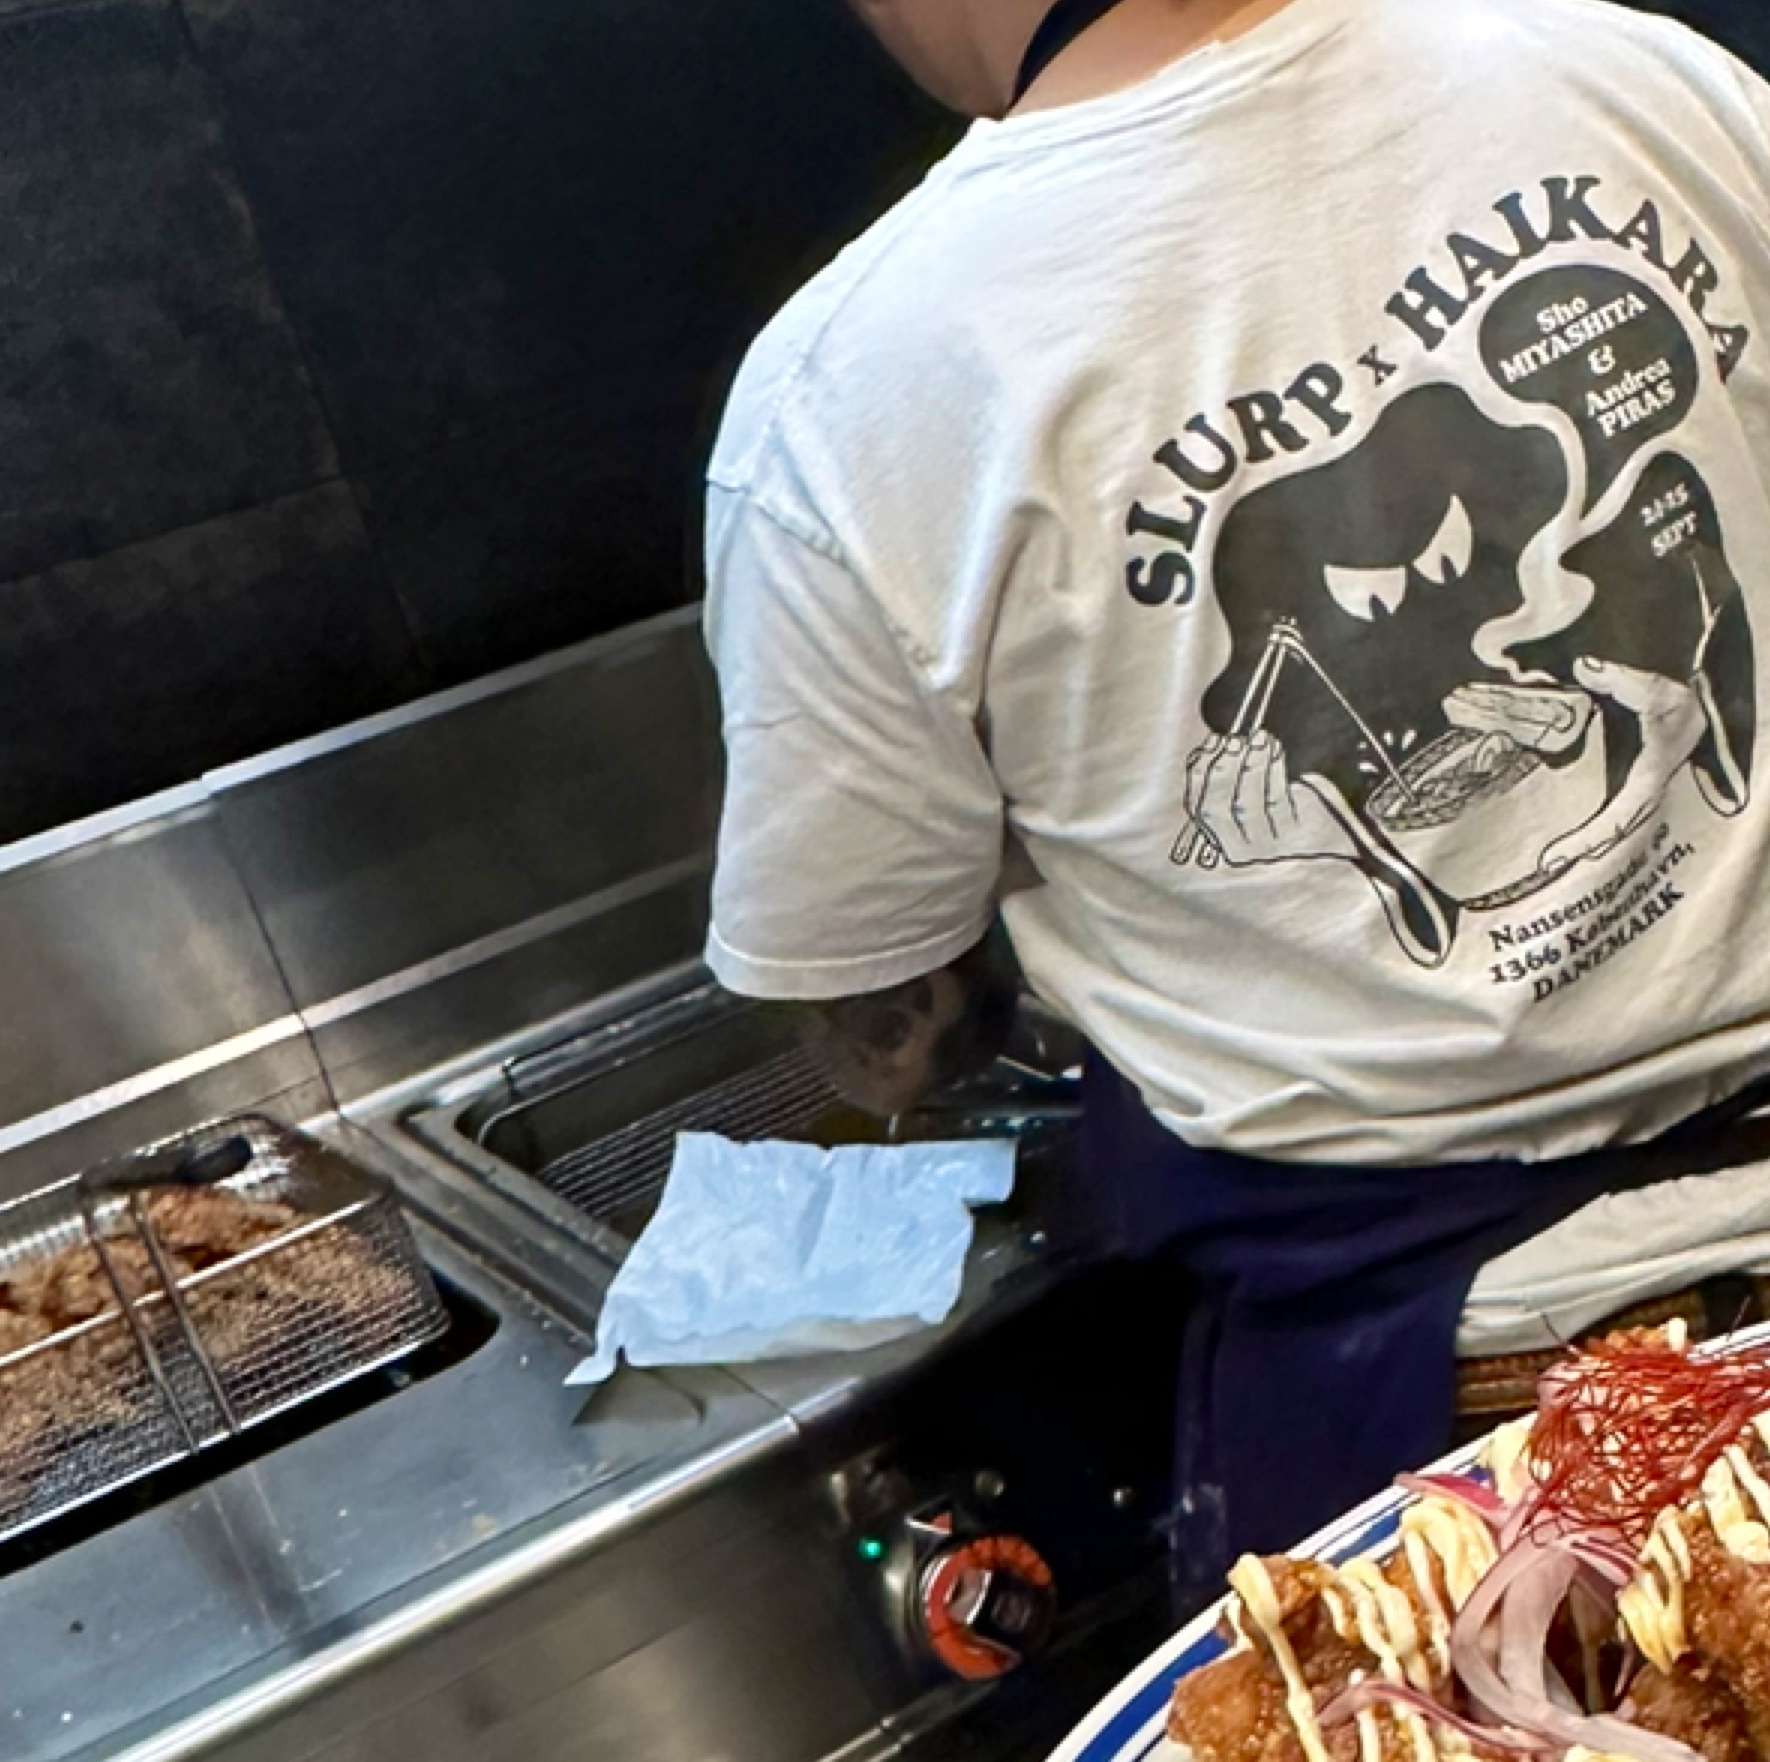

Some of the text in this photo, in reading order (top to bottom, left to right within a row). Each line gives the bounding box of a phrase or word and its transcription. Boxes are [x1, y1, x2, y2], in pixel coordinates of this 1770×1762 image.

[1499, 292, 1648, 384] MIYASHITA
[1536, 296, 1589, 333] Sho
[1586, 357, 1672, 417] Andrea
[1587, 343, 1616, 375] &
[1126, 361, 1352, 606] SLURP
[1385, 175, 1749, 384] HAIKARA
[1597, 378, 1676, 438] PIRAS
[1651, 510, 1697, 557] SEPT
[1489, 943, 1562, 984] 1366
[1532, 880, 1685, 1004] DANEMARK
